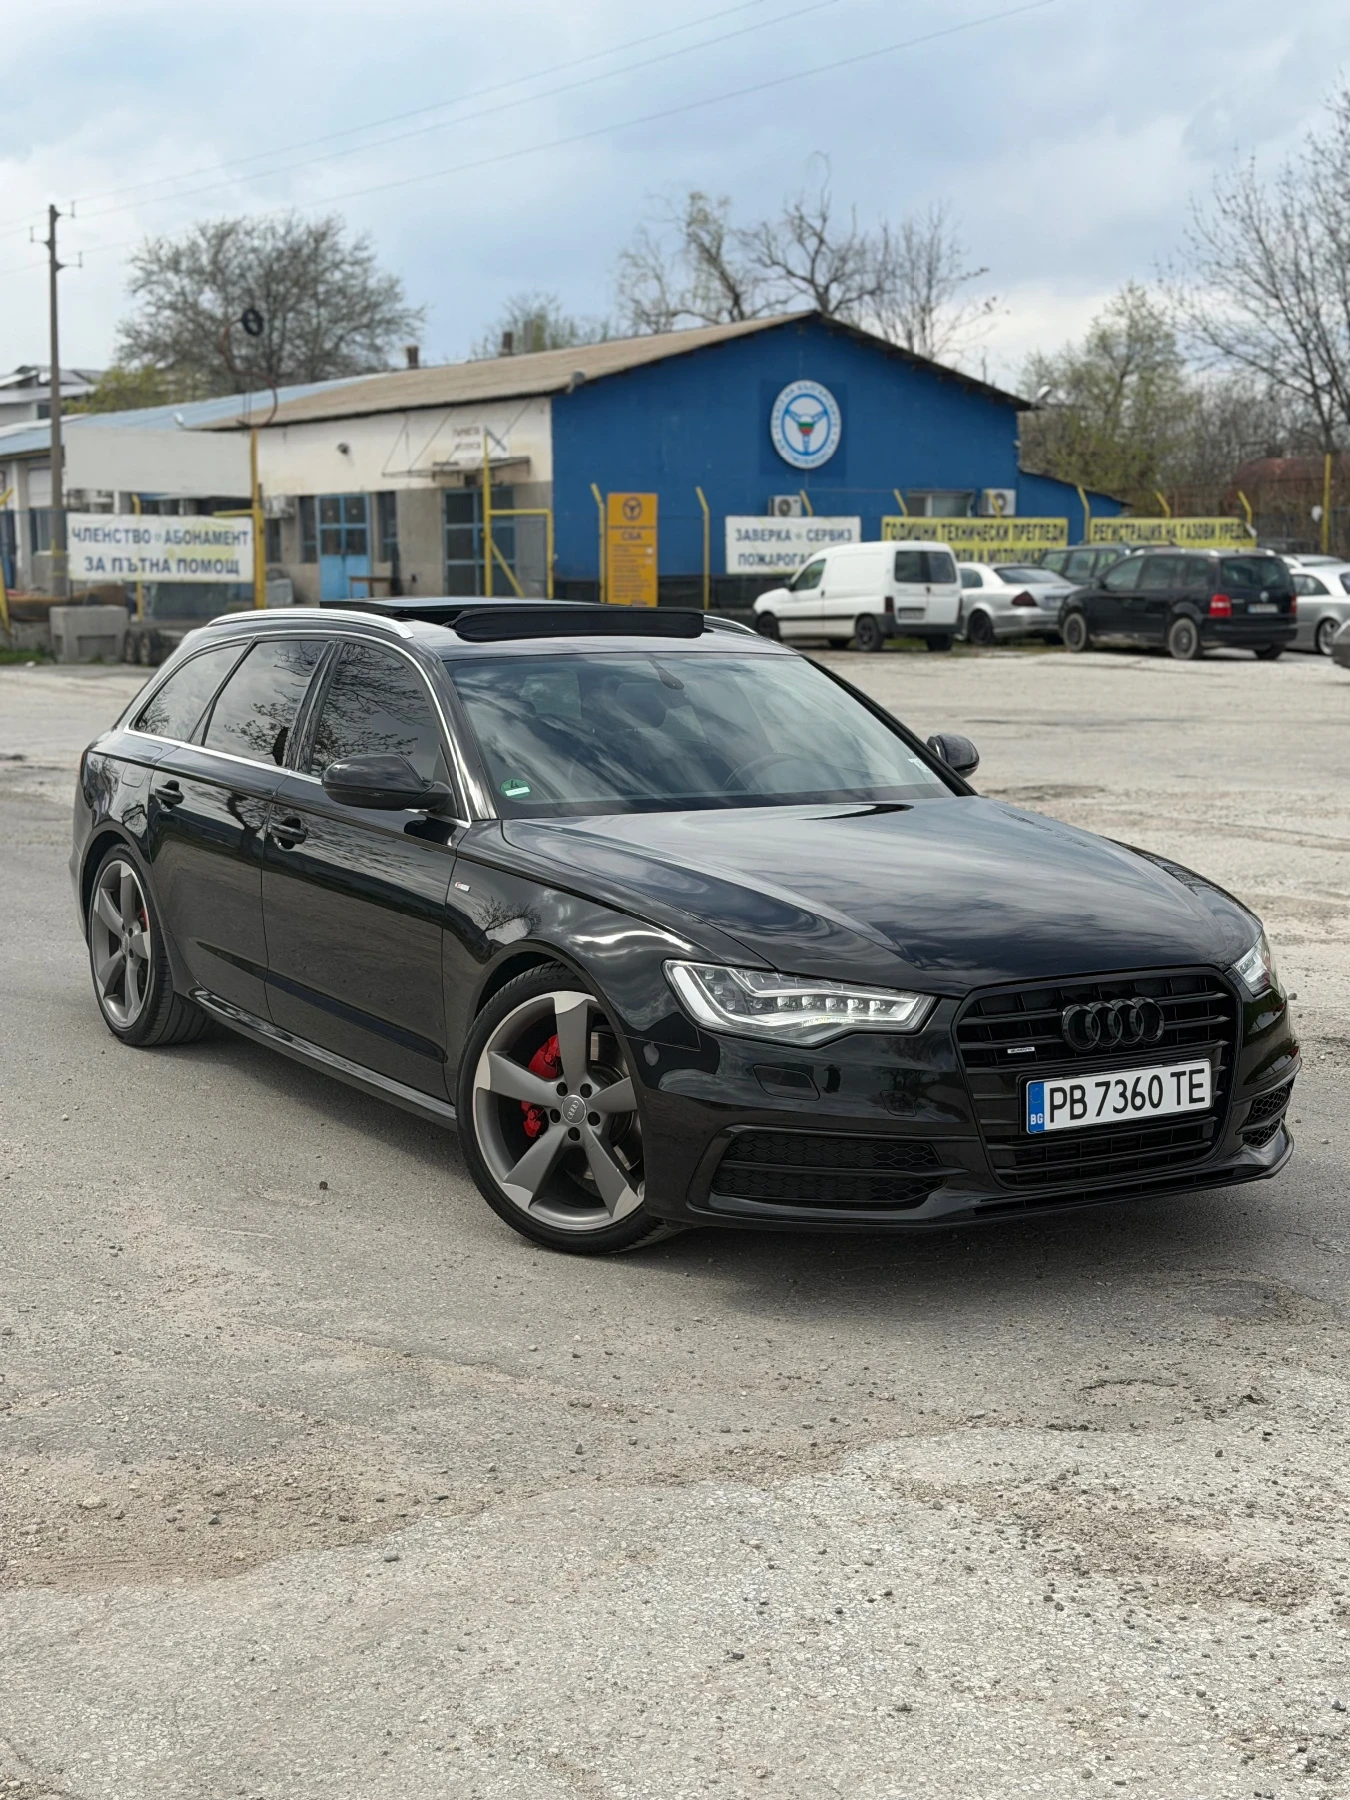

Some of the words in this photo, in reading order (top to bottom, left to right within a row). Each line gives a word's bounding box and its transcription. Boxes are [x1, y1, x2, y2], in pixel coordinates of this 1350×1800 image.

[72, 527, 151, 545] ЧЛЕНСТВО
[164, 529, 249, 546] АБОНАМЕНТ
[735, 528, 792, 542] ЗАВЕРКА
[806, 528, 853, 542] СЕРВИЗ
[885, 522, 937, 541] ГОДИШНИ
[941, 523, 1009, 542] ТЕХНИЧЕСКИ
[1013, 523, 1065, 543] ПРЕГЛЕДИ
[1093, 523, 1164, 541] РЕГИСТРАЦИЯ
[84, 556, 107, 572] ЗА
[111, 557, 174, 574] ПЪТНА
[176, 558, 241, 576] ПОМОЩ
[1049, 1084, 1088, 1124] PB
[1094, 1074, 1164, 1118] 7360
[1169, 1068, 1206, 1106] TE
[1030, 1112, 1044, 1126] BG
